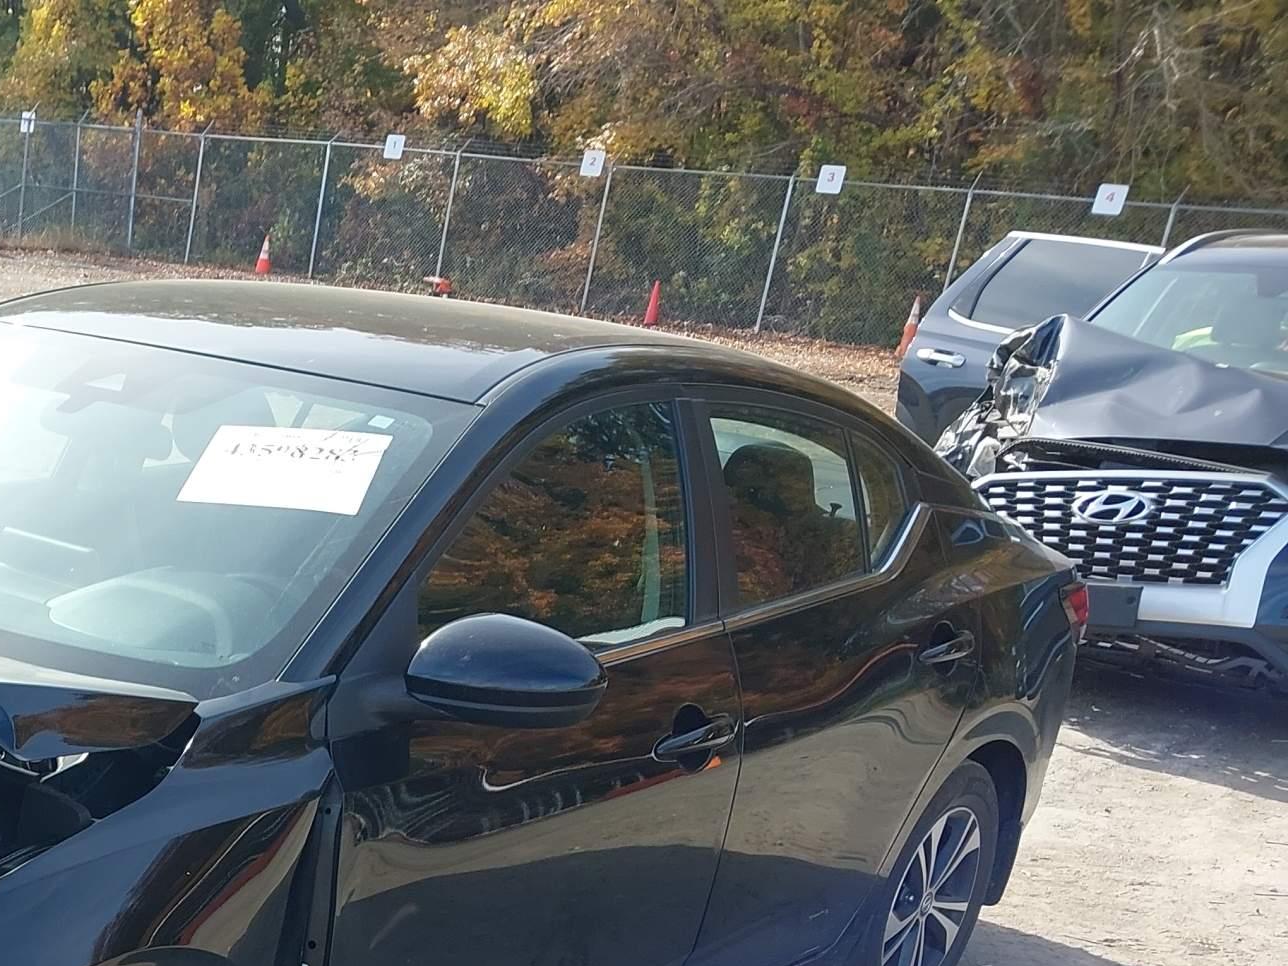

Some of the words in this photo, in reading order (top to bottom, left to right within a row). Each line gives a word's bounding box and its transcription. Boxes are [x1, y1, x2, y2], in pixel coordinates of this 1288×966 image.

[589, 157, 597, 166] 2
[827, 172, 835, 182] 3
[1105, 192, 1116, 202] 4
